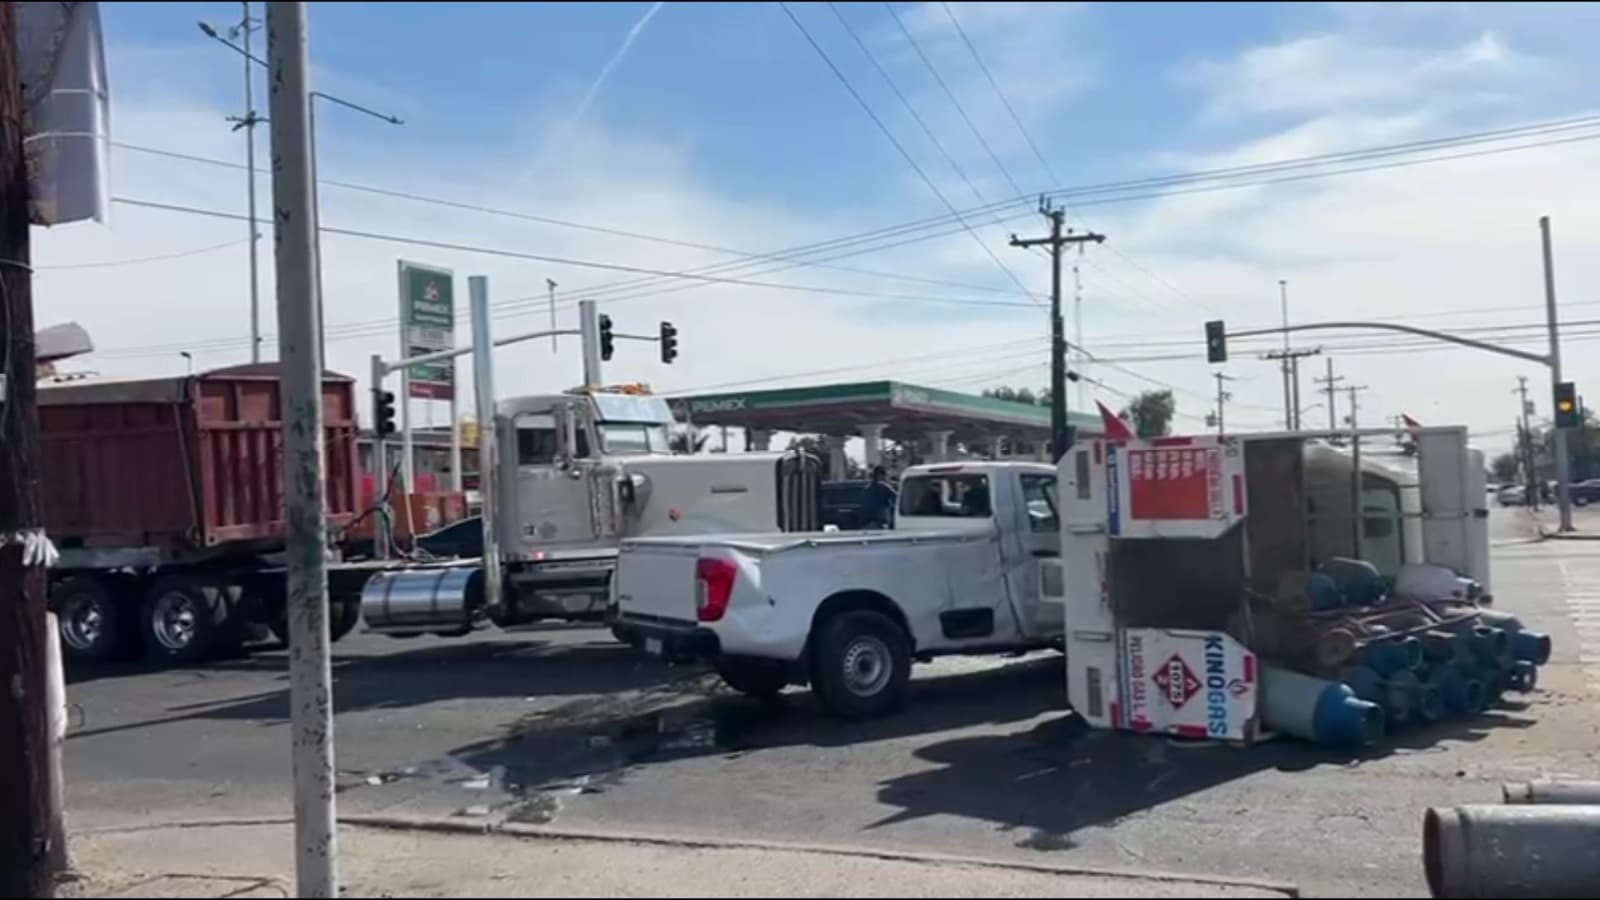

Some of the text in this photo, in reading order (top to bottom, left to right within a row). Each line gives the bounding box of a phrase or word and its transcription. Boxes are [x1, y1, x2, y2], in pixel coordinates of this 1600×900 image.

[691, 398, 747, 413] PEMEX
[1130, 636, 1145, 679] PELIGRO
[1132, 680, 1147, 702] GAS
[1171, 664, 1184, 700] 1075
[1205, 634, 1228, 737] KINOGAS
